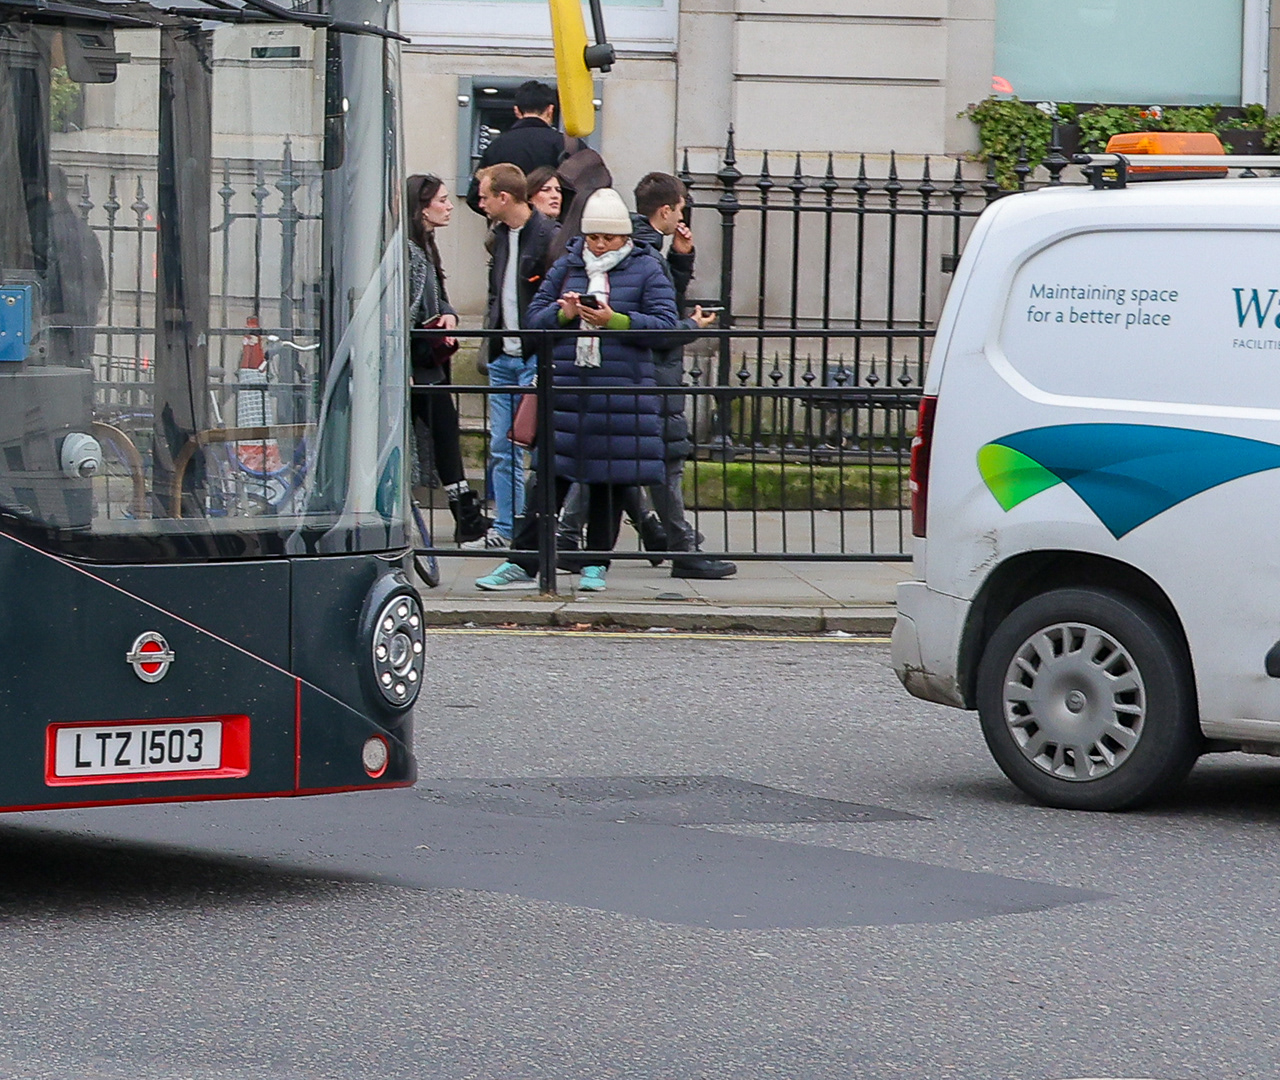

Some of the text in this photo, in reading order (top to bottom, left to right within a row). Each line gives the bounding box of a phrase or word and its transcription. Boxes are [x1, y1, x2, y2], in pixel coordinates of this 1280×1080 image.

[1029, 284, 1179, 307] Maintaining space
[1027, 305, 1172, 329] for a better place
[75, 728, 204, 768] LTZ 1503
